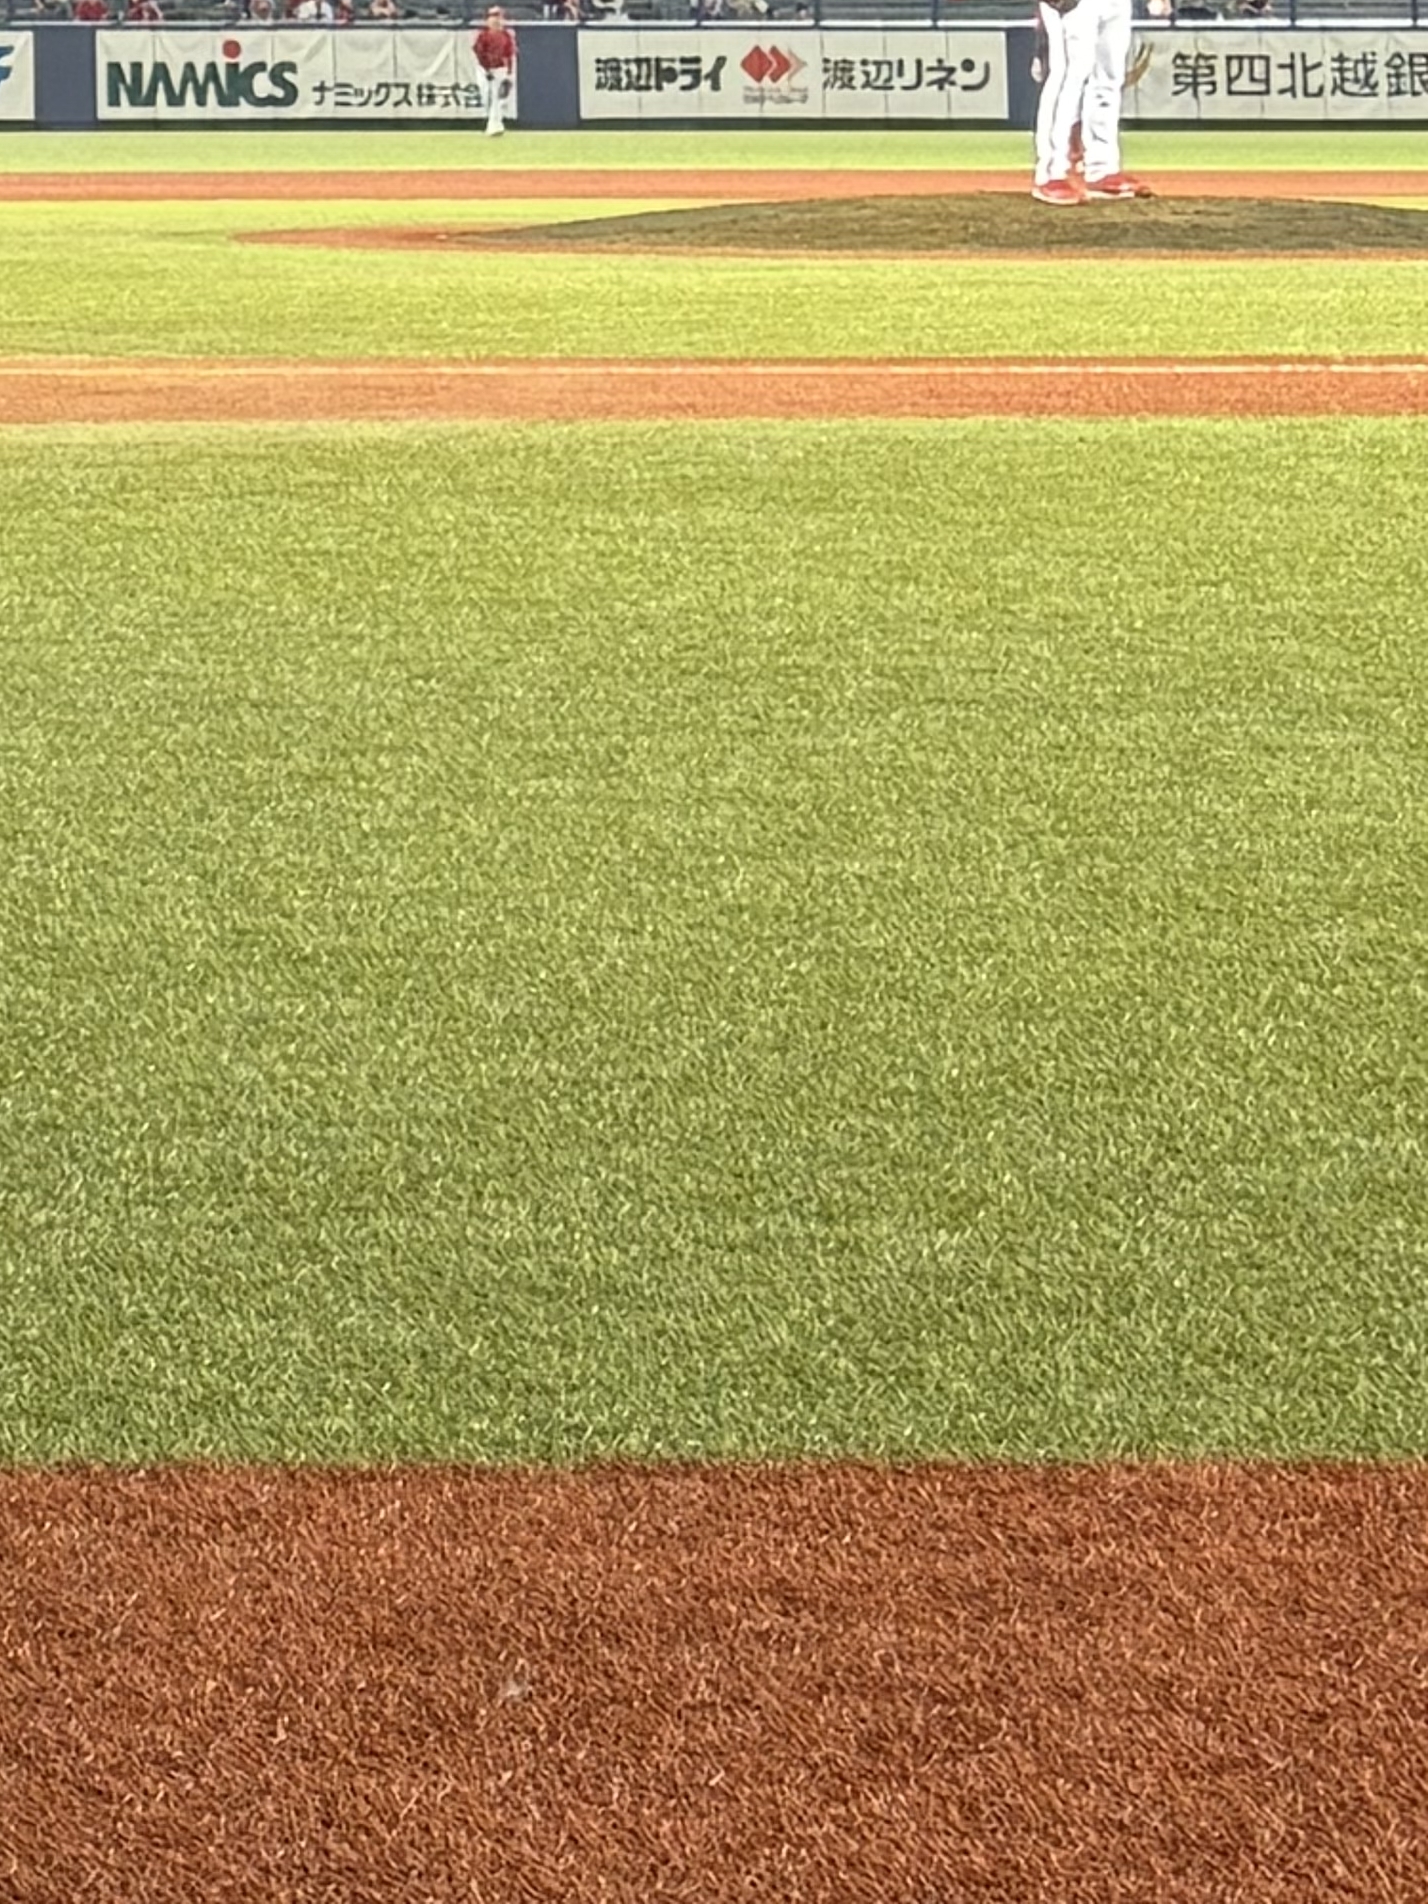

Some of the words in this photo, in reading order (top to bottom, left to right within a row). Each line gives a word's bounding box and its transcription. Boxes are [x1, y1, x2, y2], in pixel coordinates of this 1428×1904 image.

[822, 57, 991, 91] 渡辺リネン
[1171, 52, 1428, 98] 第四北越銀
[312, 80, 484, 108] ナミックス株式会
